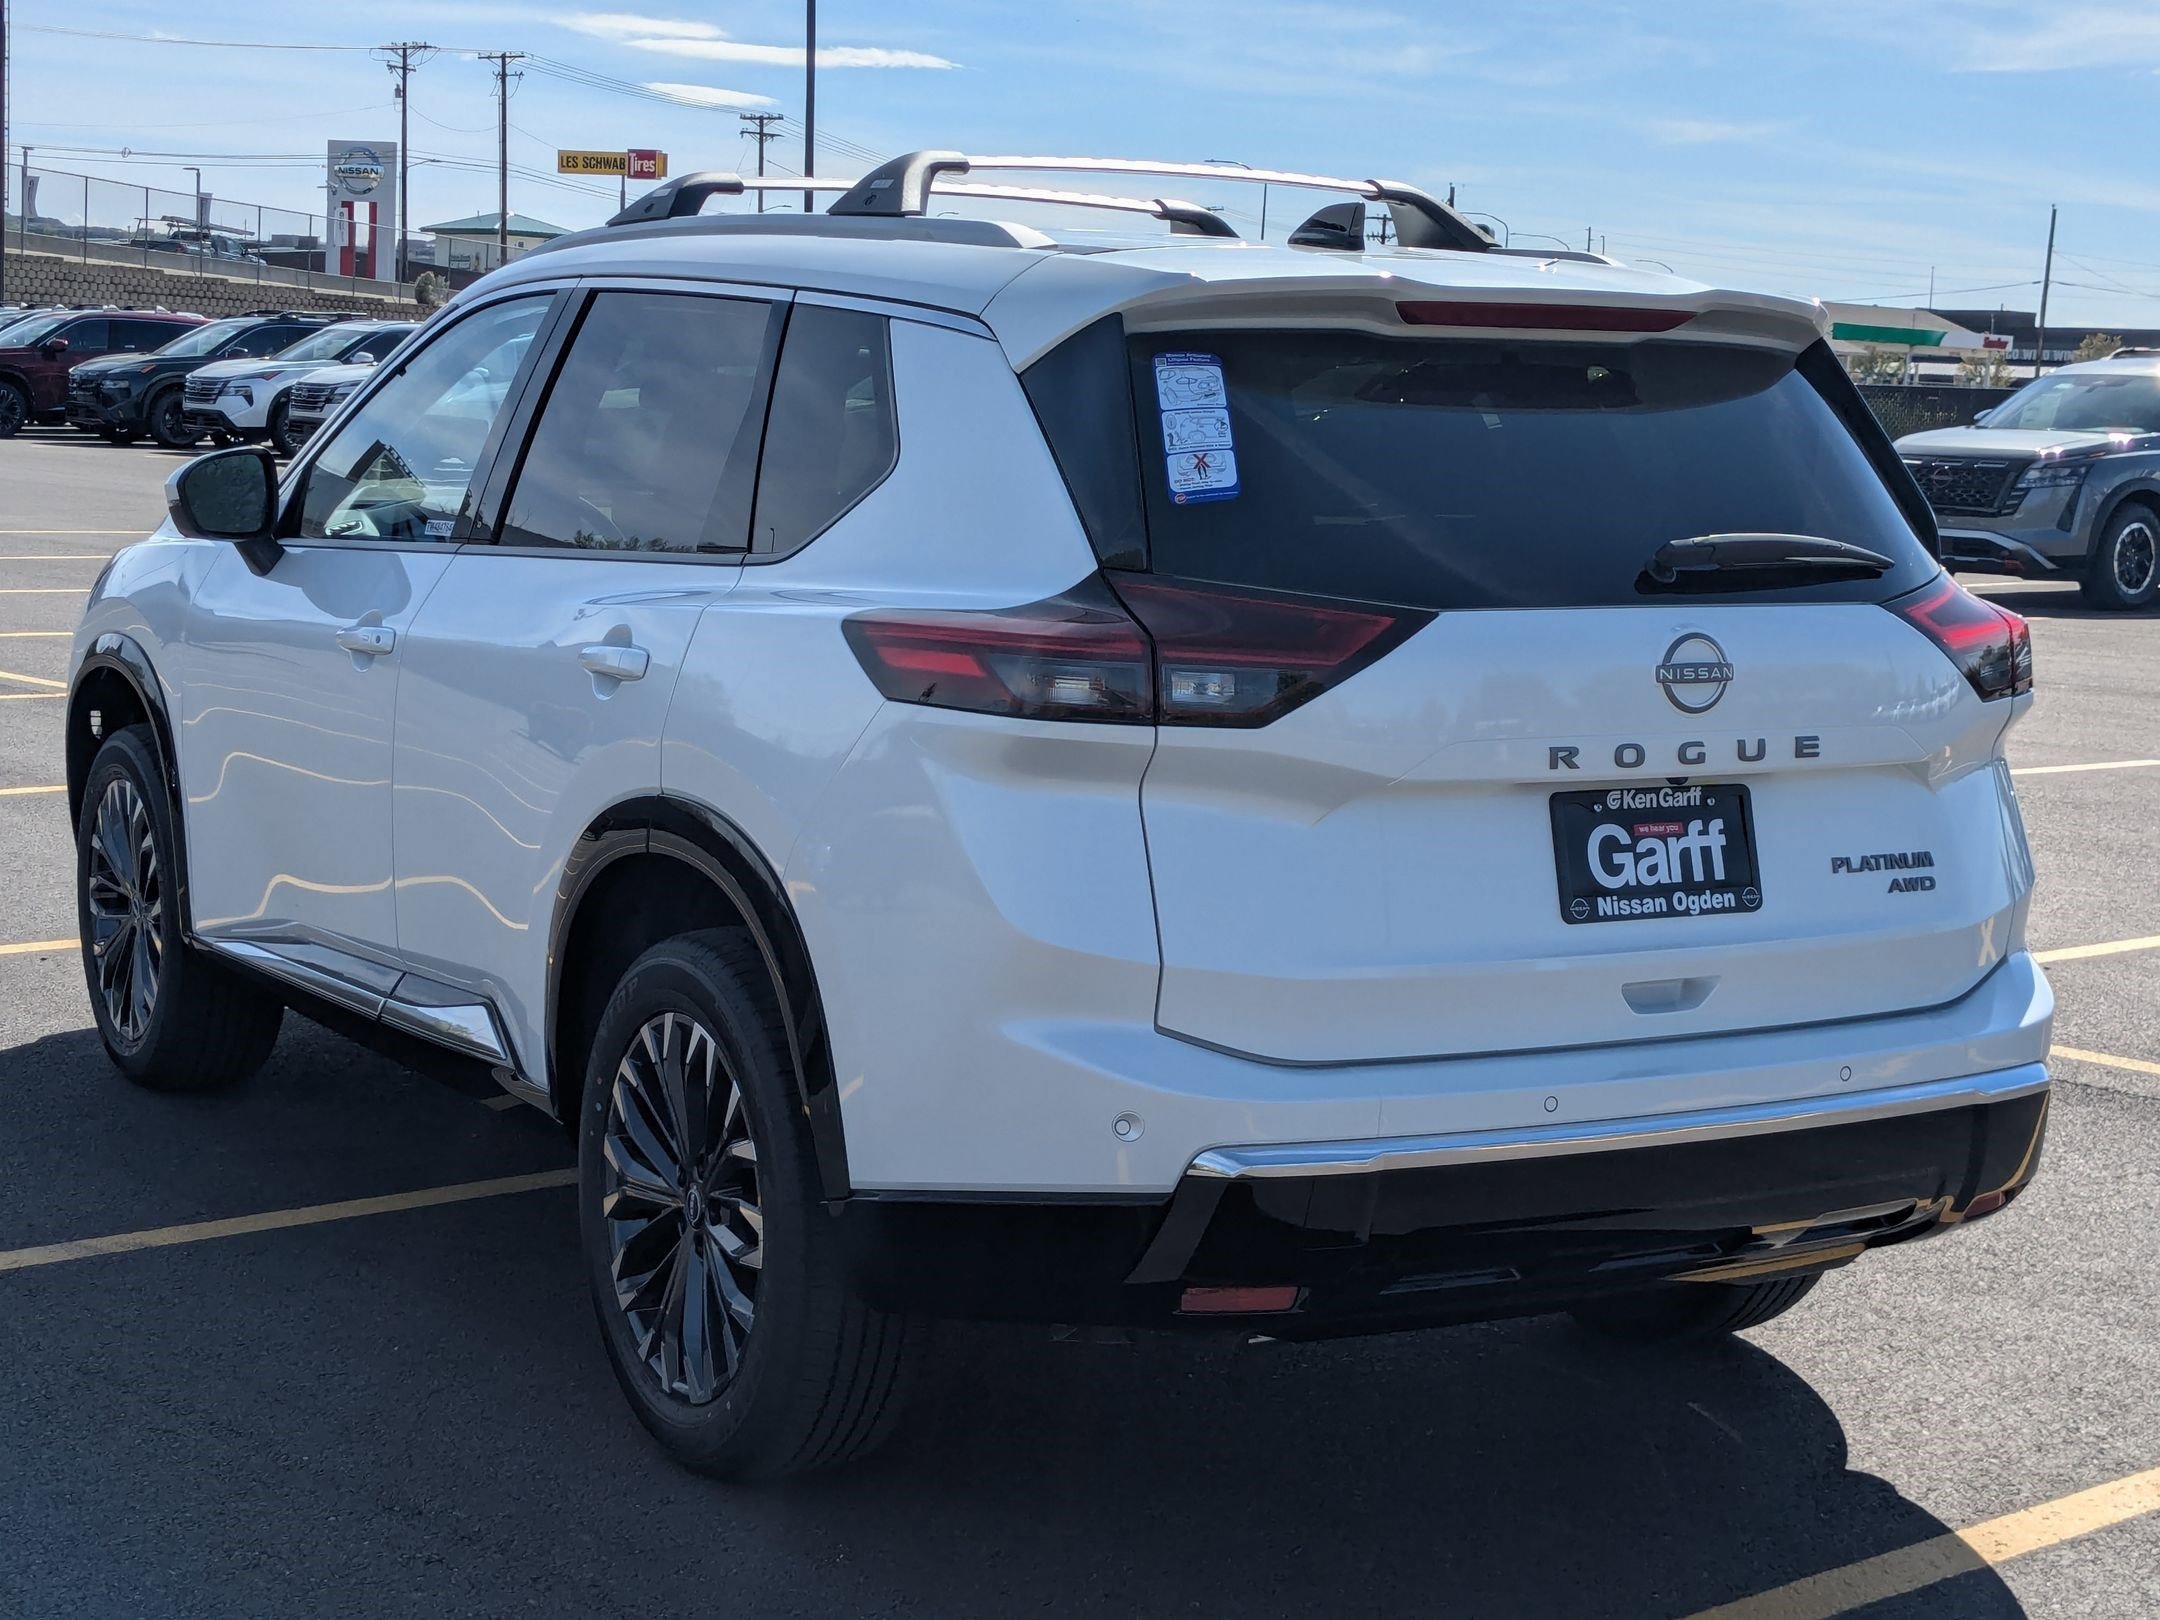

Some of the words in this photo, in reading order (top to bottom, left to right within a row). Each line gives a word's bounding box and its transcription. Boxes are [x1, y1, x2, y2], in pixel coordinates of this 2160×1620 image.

[338, 166, 379, 175] NISSAN
[561, 155, 579, 169] LES
[582, 156, 626, 171] SCHWAB
[628, 152, 656, 176] Tires
[1658, 666, 1734, 681] NISSAN
[1548, 735, 1821, 770] ROGUE
[1587, 818, 1727, 889] Garff
[1830, 850, 1935, 874] PLATINUM
[1887, 875, 1937, 894] AWD
[1597, 896, 1668, 917] Nissan
[1672, 889, 1736, 916] Ogden
